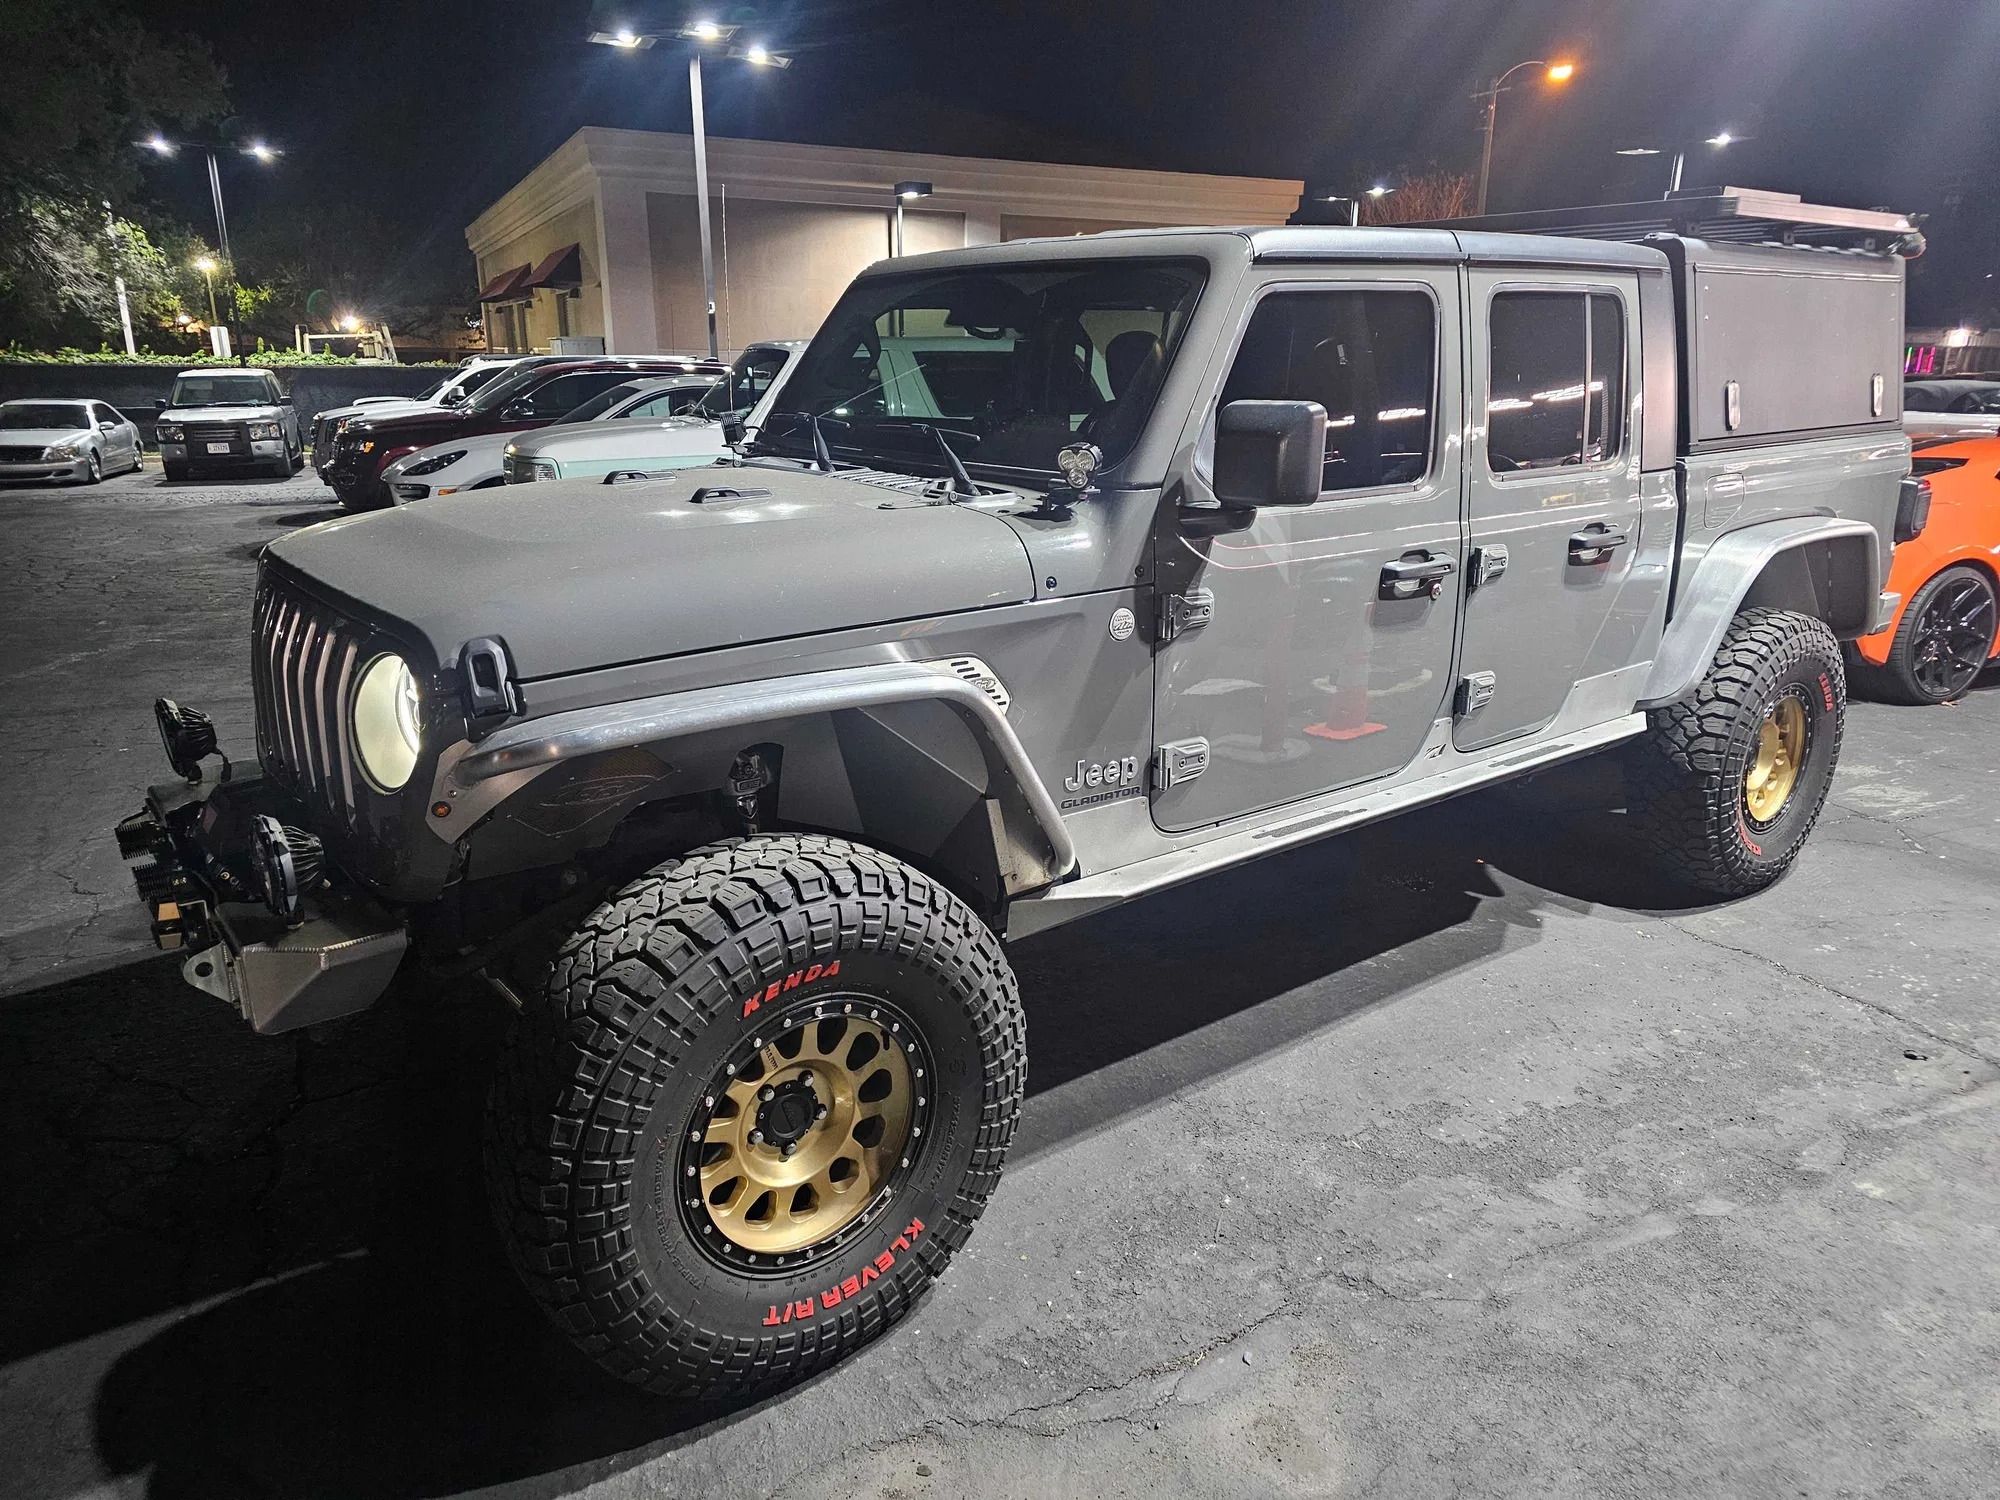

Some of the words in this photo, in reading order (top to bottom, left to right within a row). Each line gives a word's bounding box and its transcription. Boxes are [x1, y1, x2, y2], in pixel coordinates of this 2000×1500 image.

[1818, 672, 1834, 711] KENDA
[1064, 756, 1139, 792] Jeep
[1060, 786, 1141, 810] GLADIATOR
[743, 960, 841, 1018] KENDA
[820, 1216, 926, 1310] KLEVER
